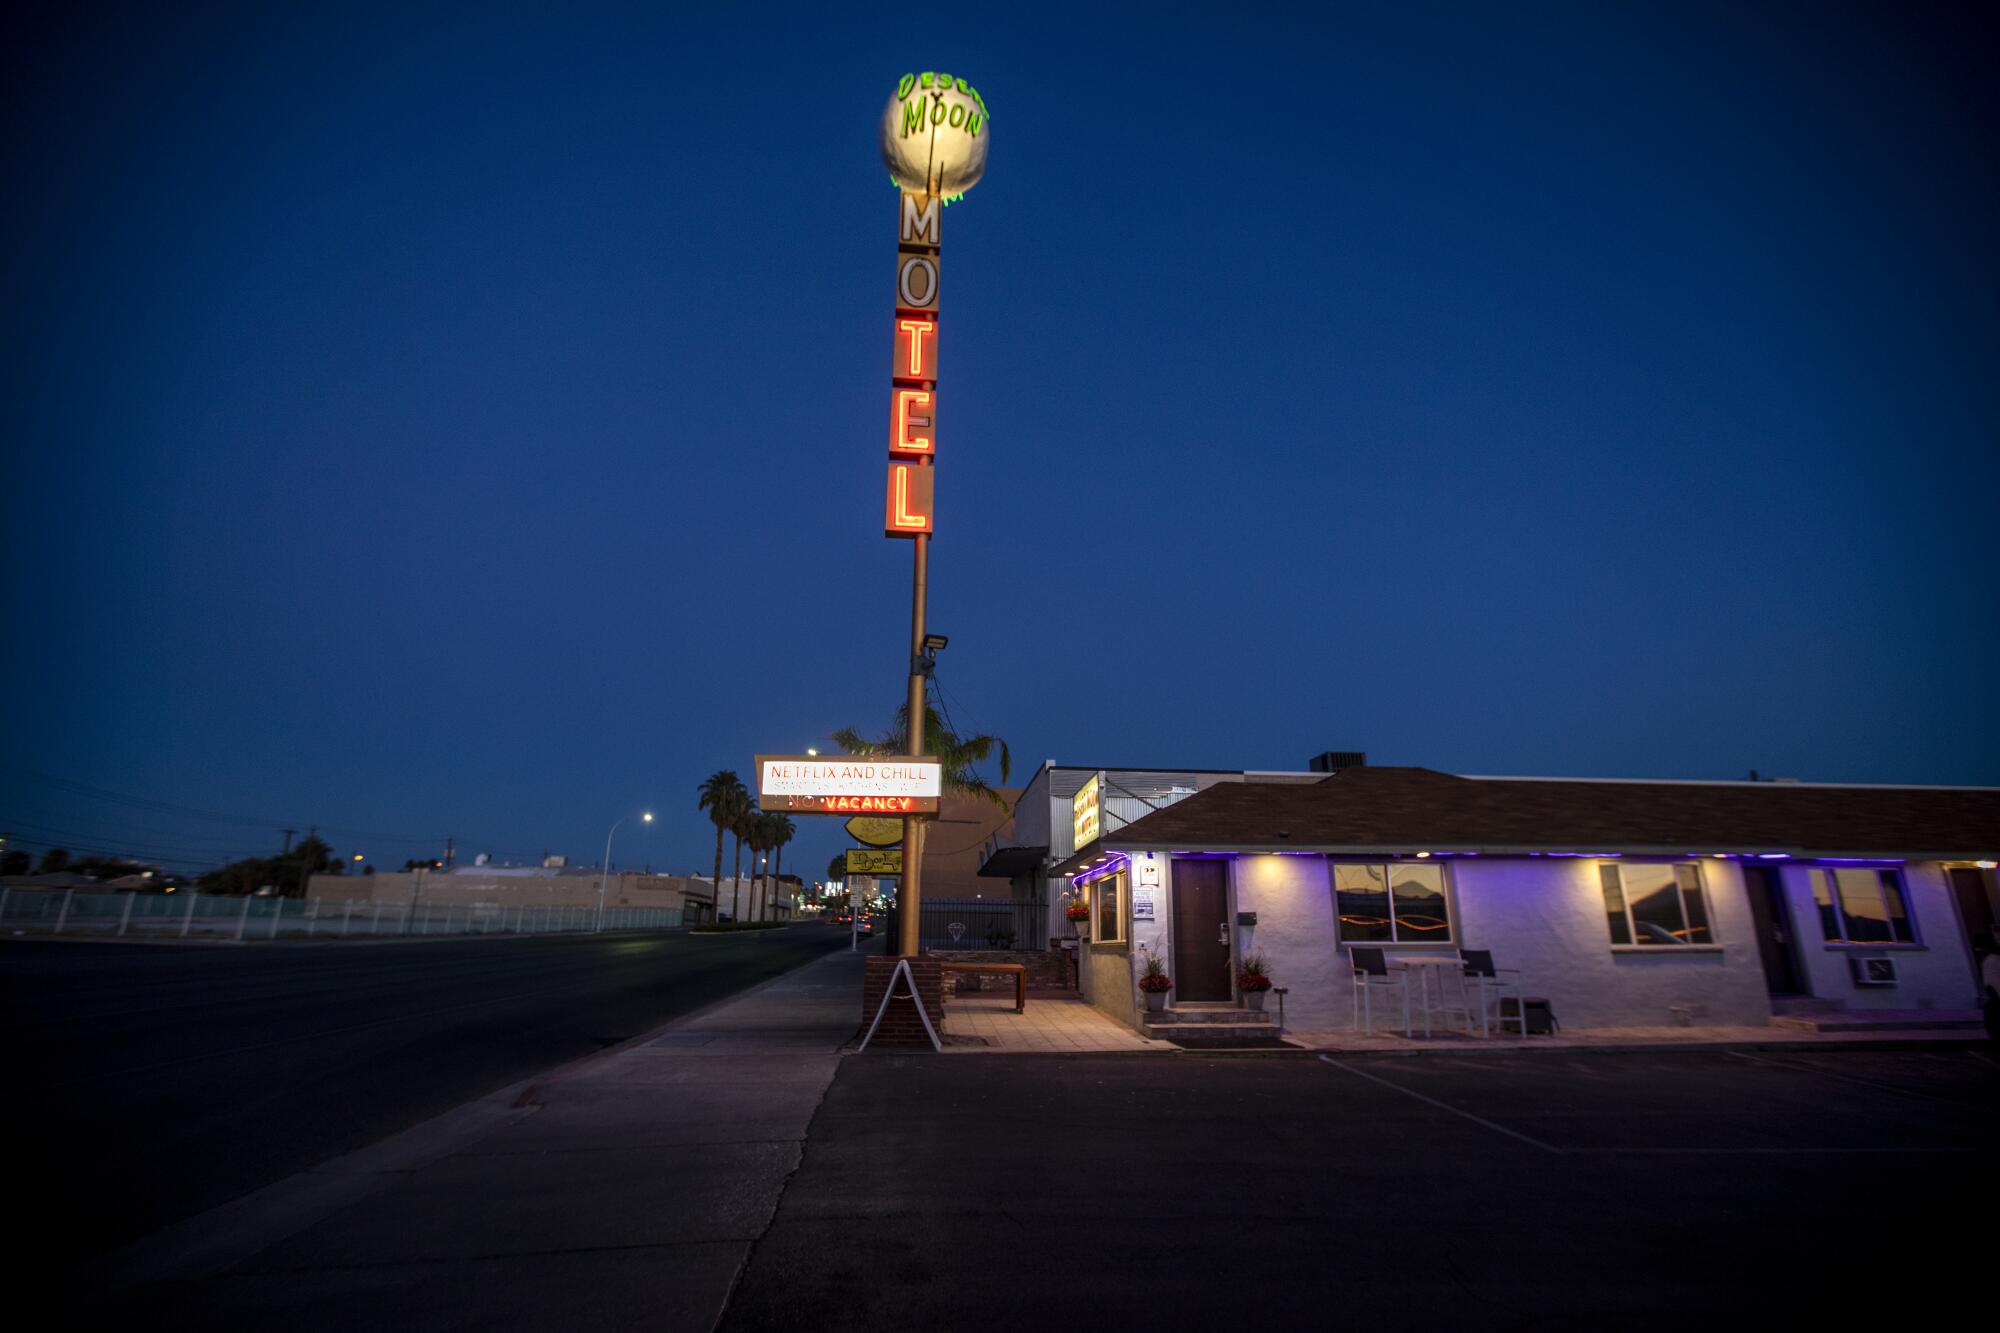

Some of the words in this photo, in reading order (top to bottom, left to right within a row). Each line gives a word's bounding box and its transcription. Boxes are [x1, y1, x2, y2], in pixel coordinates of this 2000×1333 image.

[898, 72, 990, 120] DESE
[902, 95, 983, 139] MOON
[896, 193, 940, 528] MOTEL
[771, 765, 836, 779] NETFLIX
[841, 766, 875, 780] AND
[881, 766, 927, 780] CHILL
[825, 796, 910, 810] VACANCY
